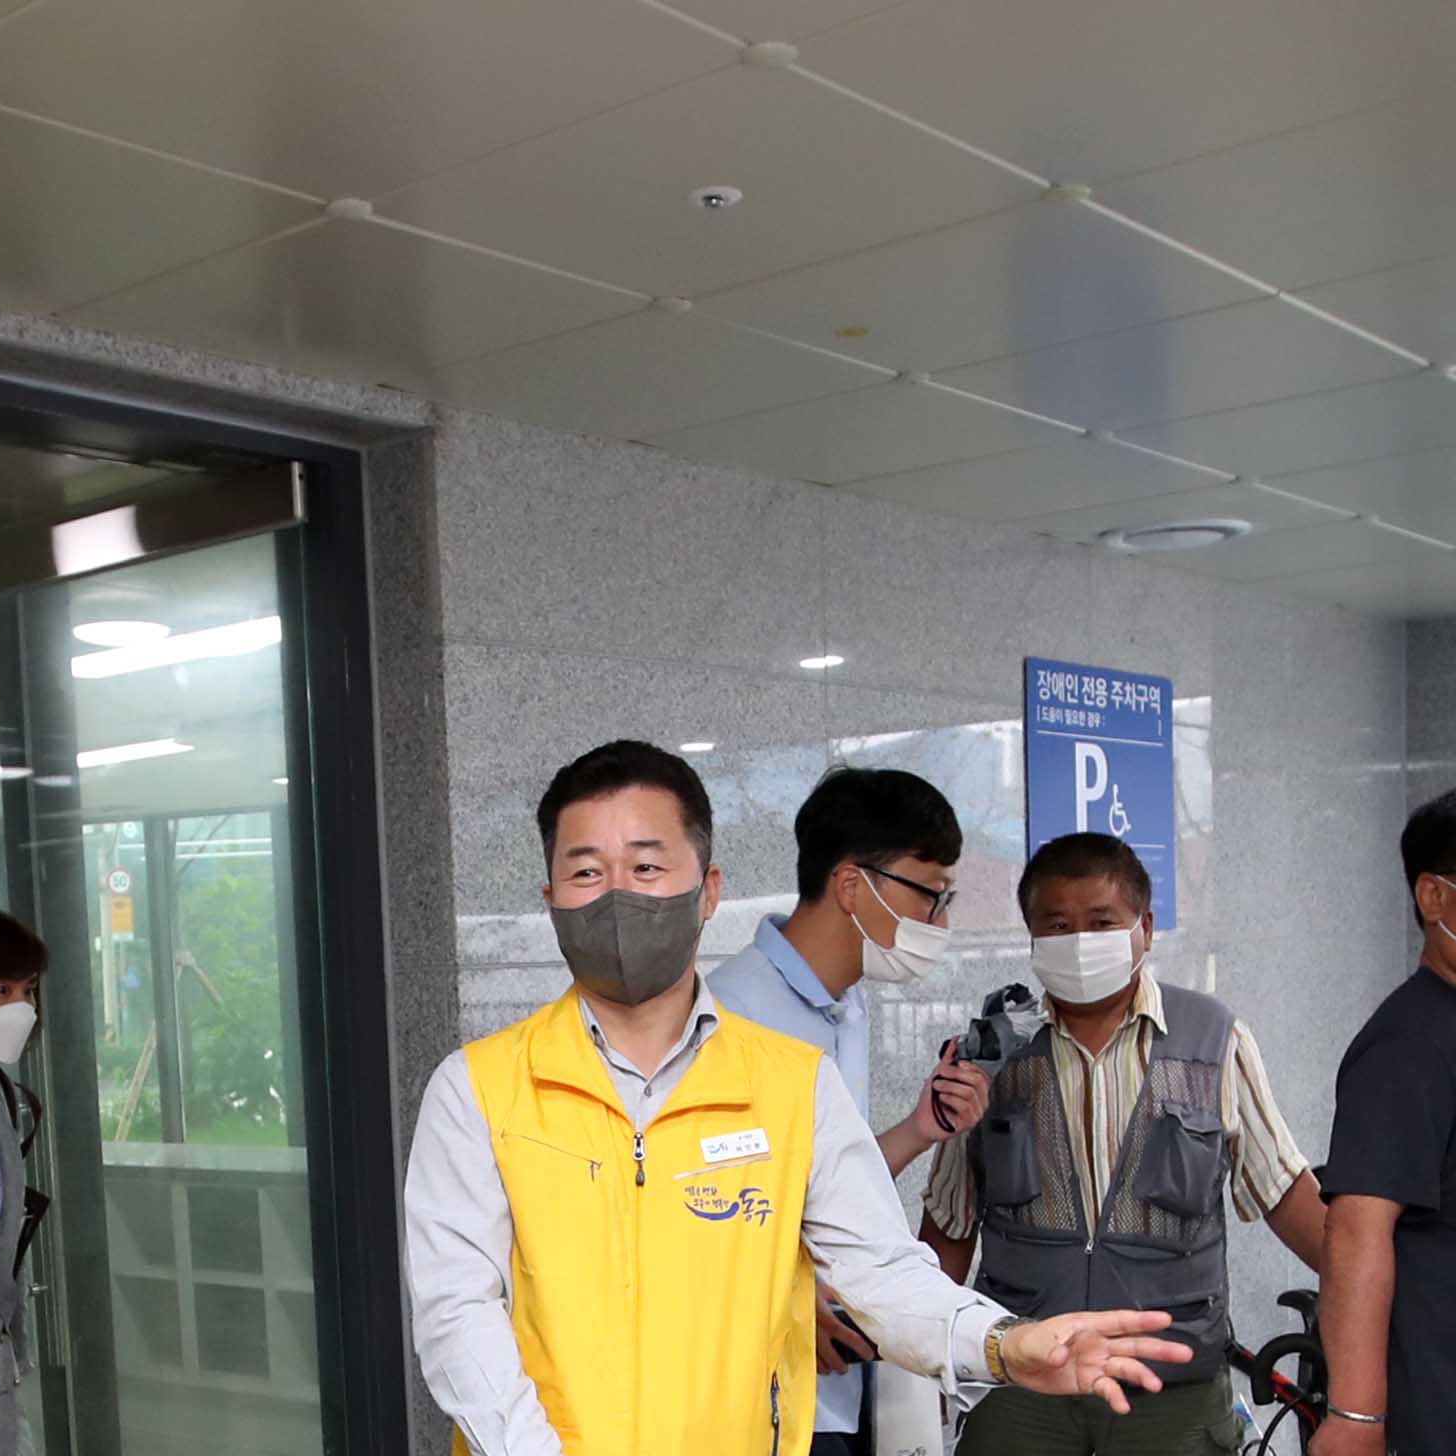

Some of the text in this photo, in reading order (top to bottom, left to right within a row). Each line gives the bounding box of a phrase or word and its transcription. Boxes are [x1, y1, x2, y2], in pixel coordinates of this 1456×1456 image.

[1036, 669, 1161, 715] 장애인 전용 주차구역
[1074, 742, 1109, 834] P
[738, 1187, 774, 1227] 동구
